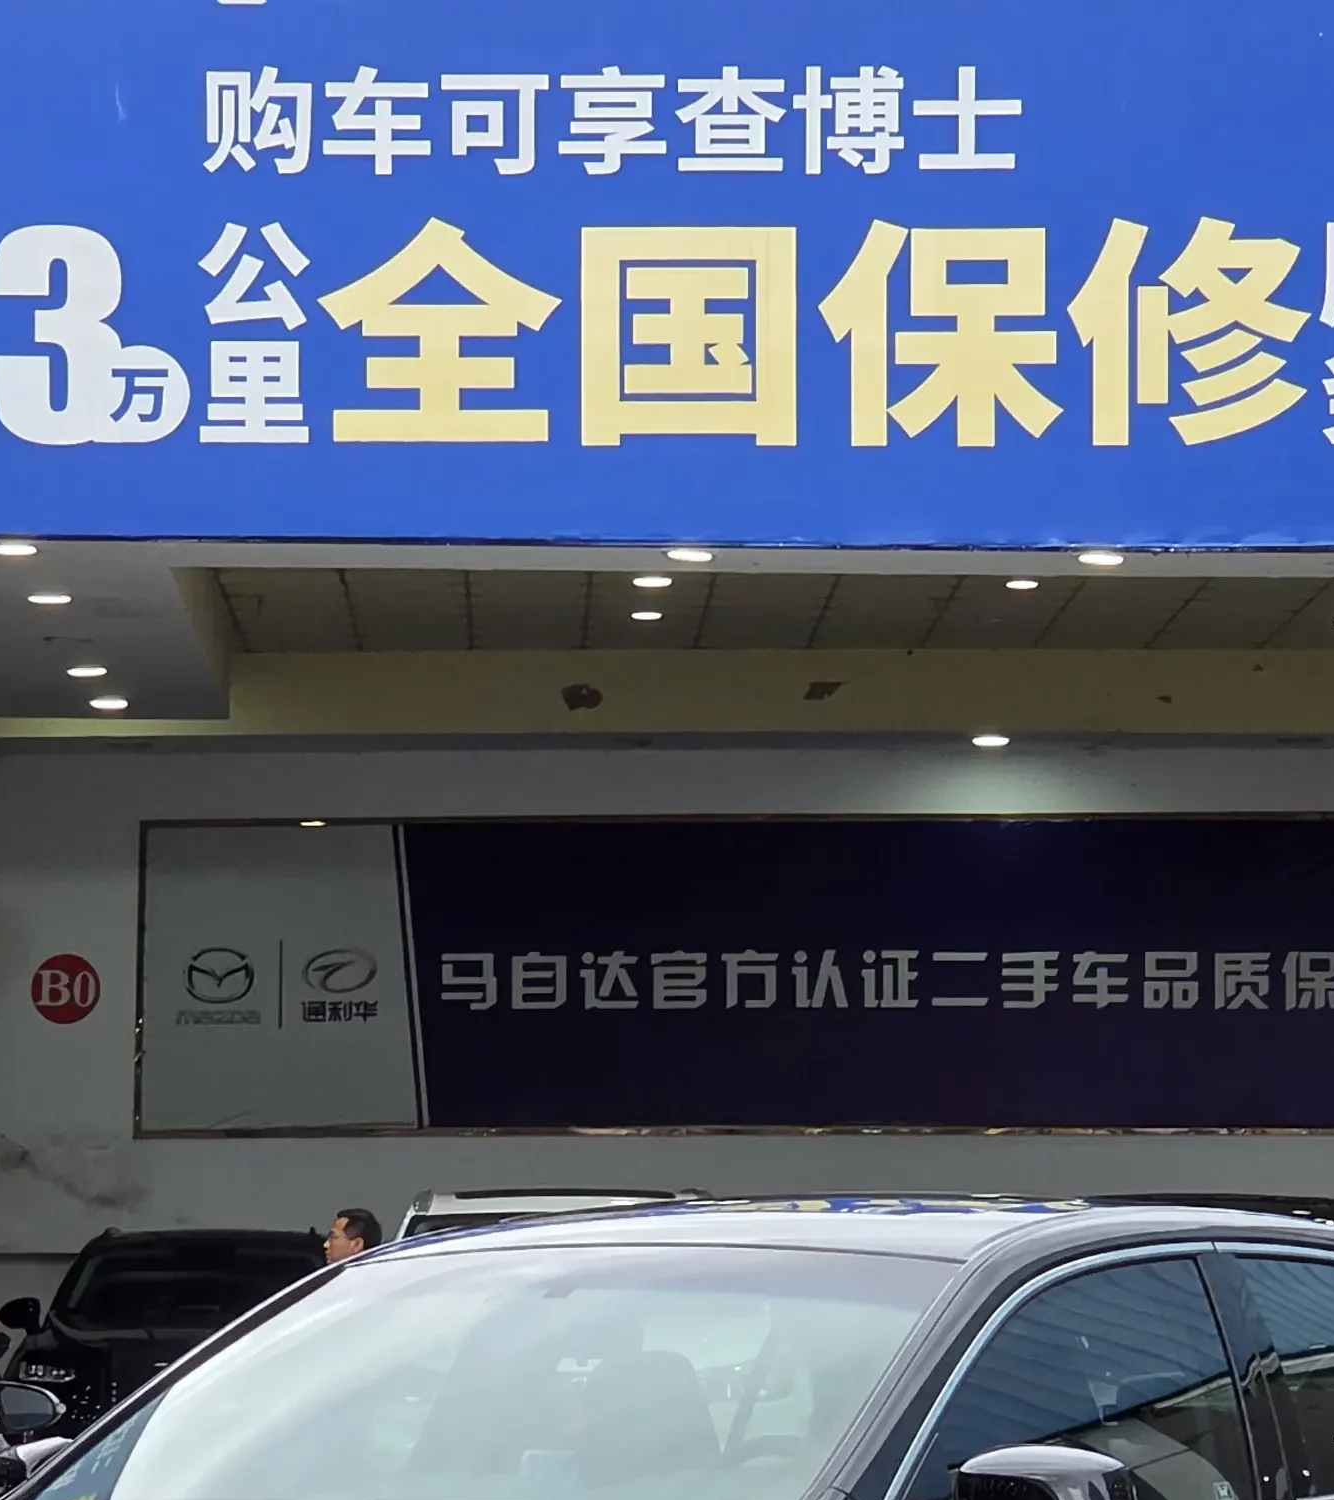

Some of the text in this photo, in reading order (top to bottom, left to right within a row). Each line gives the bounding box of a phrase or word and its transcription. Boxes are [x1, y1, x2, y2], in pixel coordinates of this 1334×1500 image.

[202, 65, 1023, 175] 购车可享查博士
[300, 1000, 379, 1023] 通利华
